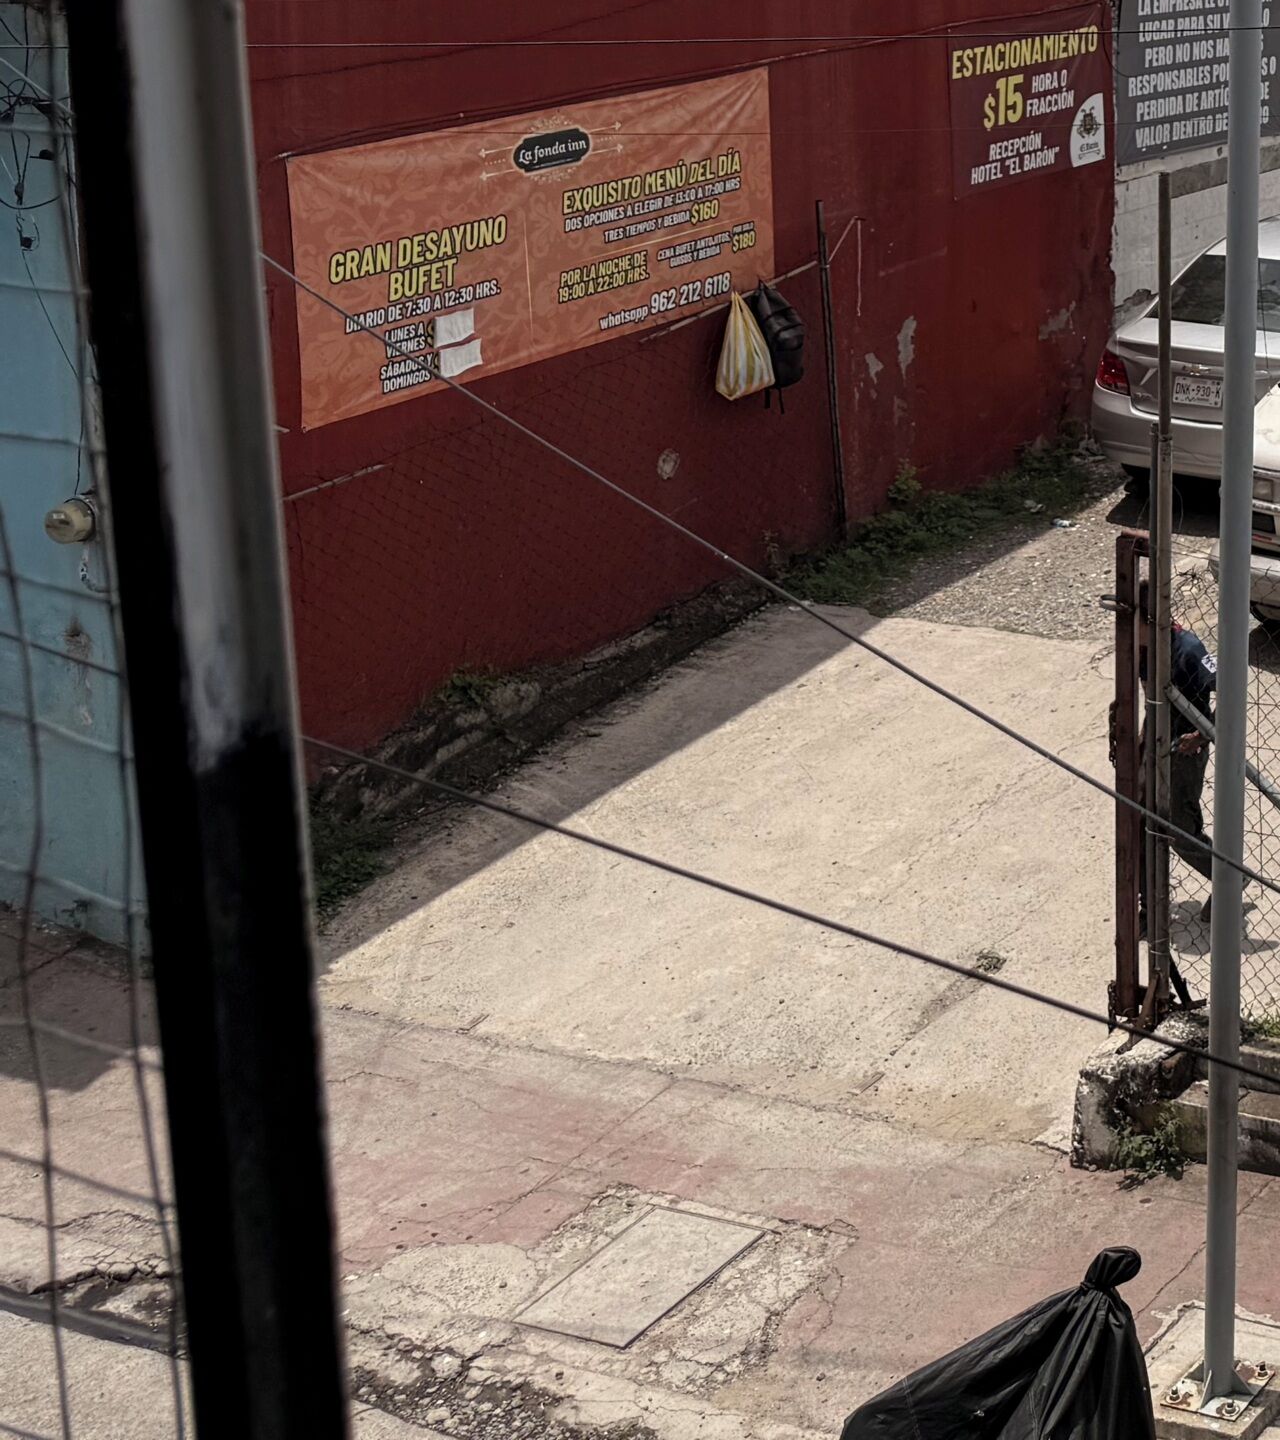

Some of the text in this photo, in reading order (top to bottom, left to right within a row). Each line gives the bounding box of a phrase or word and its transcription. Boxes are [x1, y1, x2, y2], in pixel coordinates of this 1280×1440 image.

[1139, 18, 1175, 42] LUGAR
[1177, 14, 1205, 37] PARA
[1207, 13, 1220, 34] SU
[952, 25, 1098, 79] ESTACIONAMIENTO
[1145, 45, 1173, 68] PERO
[1175, 42, 1190, 63] NO
[1192, 41, 1214, 60] NOS
[1128, 66, 1210, 97] RESPONSABLES
[983, 69, 1068, 131] $15 HORA O
[1026, 88, 1074, 117] FRACCIÓN
[1136, 95, 1183, 122] PERDIDA
[1185, 92, 1198, 110] DE
[1200, 85, 1230, 111] ARTÍC
[989, 130, 1042, 160] RECEPCIÓN
[1136, 112, 1229, 148] VALOR DENTRO DE
[518, 149, 533, 164] La
[534, 141, 567, 163] fonda
[568, 139, 587, 153] inn
[563, 148, 741, 215] EXQUISITO MENÚ DEL DÍA
[971, 162, 1003, 184] HOTEL
[565, 218, 582, 232] DOS
[584, 207, 625, 227] OPCIONES
[626, 204, 633, 216] A
[634, 198, 663, 215] ELEGIR
[697, 187, 703, 199] A
[604, 199, 719, 243] TRES TIEMPOS Y BEBIDA $160
[330, 215, 507, 283] GRAN DESAYUNO
[732, 231, 755, 252] $180
[389, 258, 457, 301] BUFET
[558, 267, 650, 303] 19:00 A 22:00 HRS.
[561, 251, 647, 287] POR LA NOCHE DE
[345, 280, 501, 334] DIARIO DE 7:30 A 12:30 HRS.
[600, 273, 731, 329] whatsapp 962 212 6118
[385, 324, 416, 342] LUNES
[418, 322, 425, 336] A
[426, 353, 433, 368] Y
[383, 370, 431, 394] DOMINGOS
